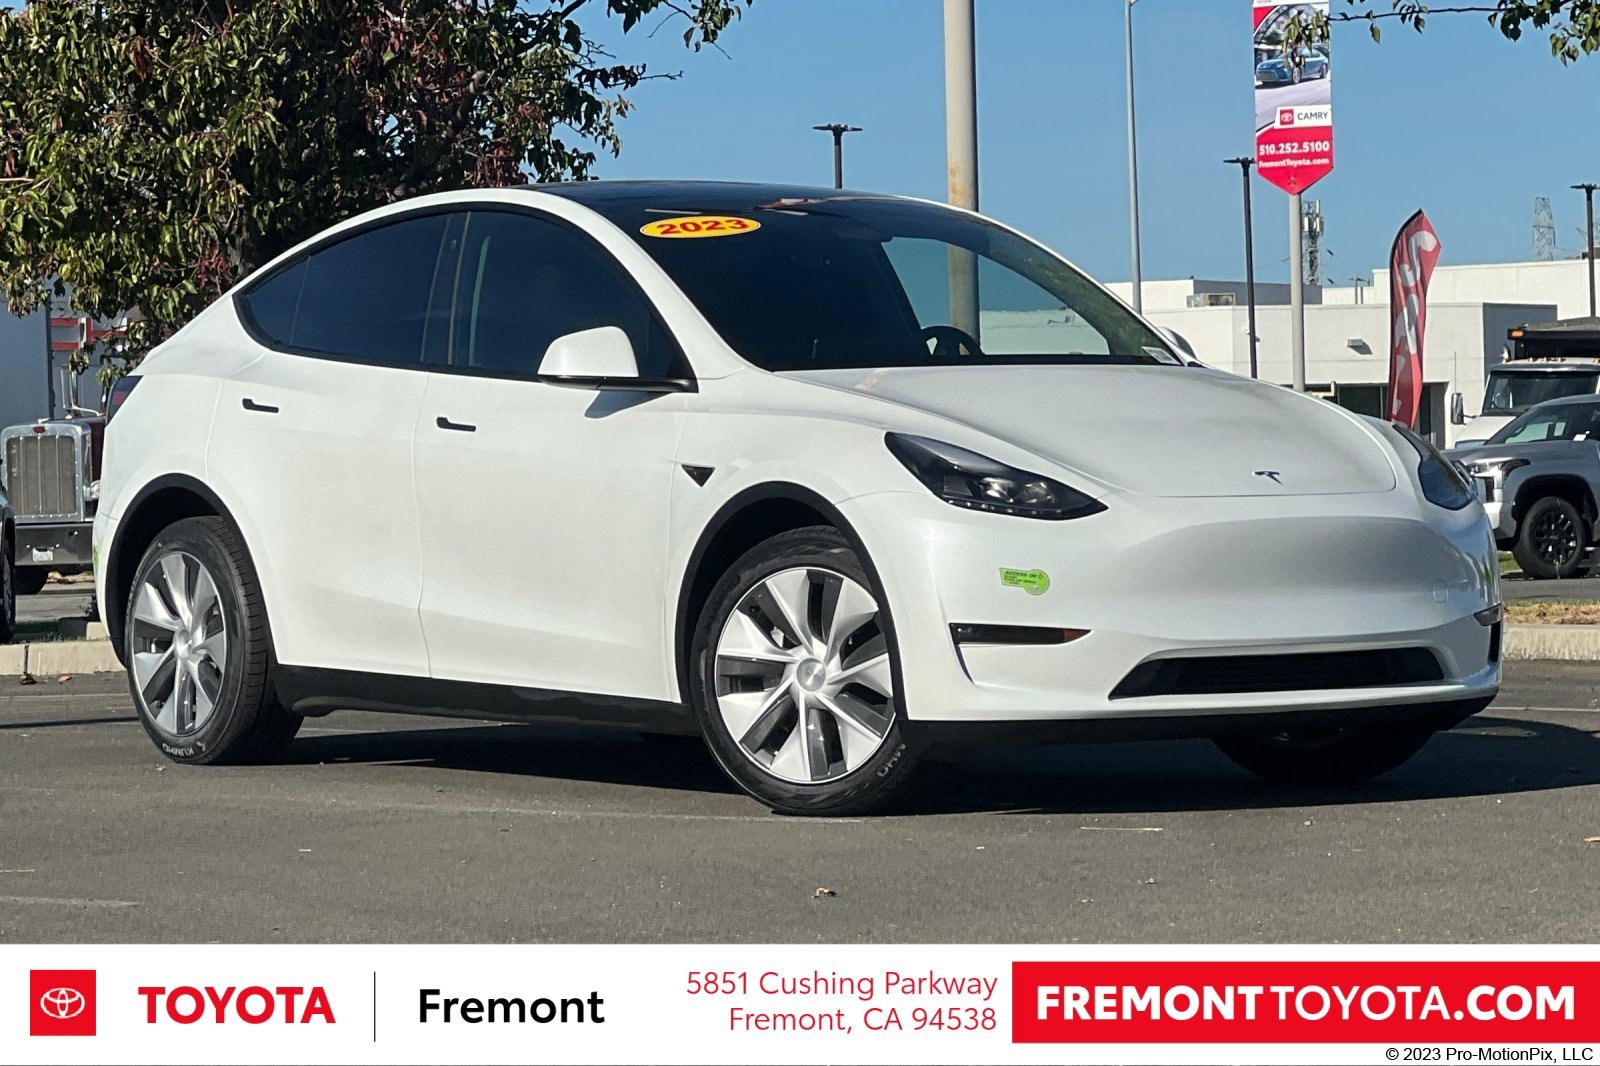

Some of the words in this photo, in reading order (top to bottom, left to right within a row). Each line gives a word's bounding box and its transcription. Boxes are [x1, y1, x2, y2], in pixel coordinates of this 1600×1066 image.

[1297, 111, 1328, 121] CAMRY
[1259, 141, 1330, 155] 510.252.5100
[1258, 158, 1330, 168] FremontToyota.com
[656, 219, 750, 235] 2023
